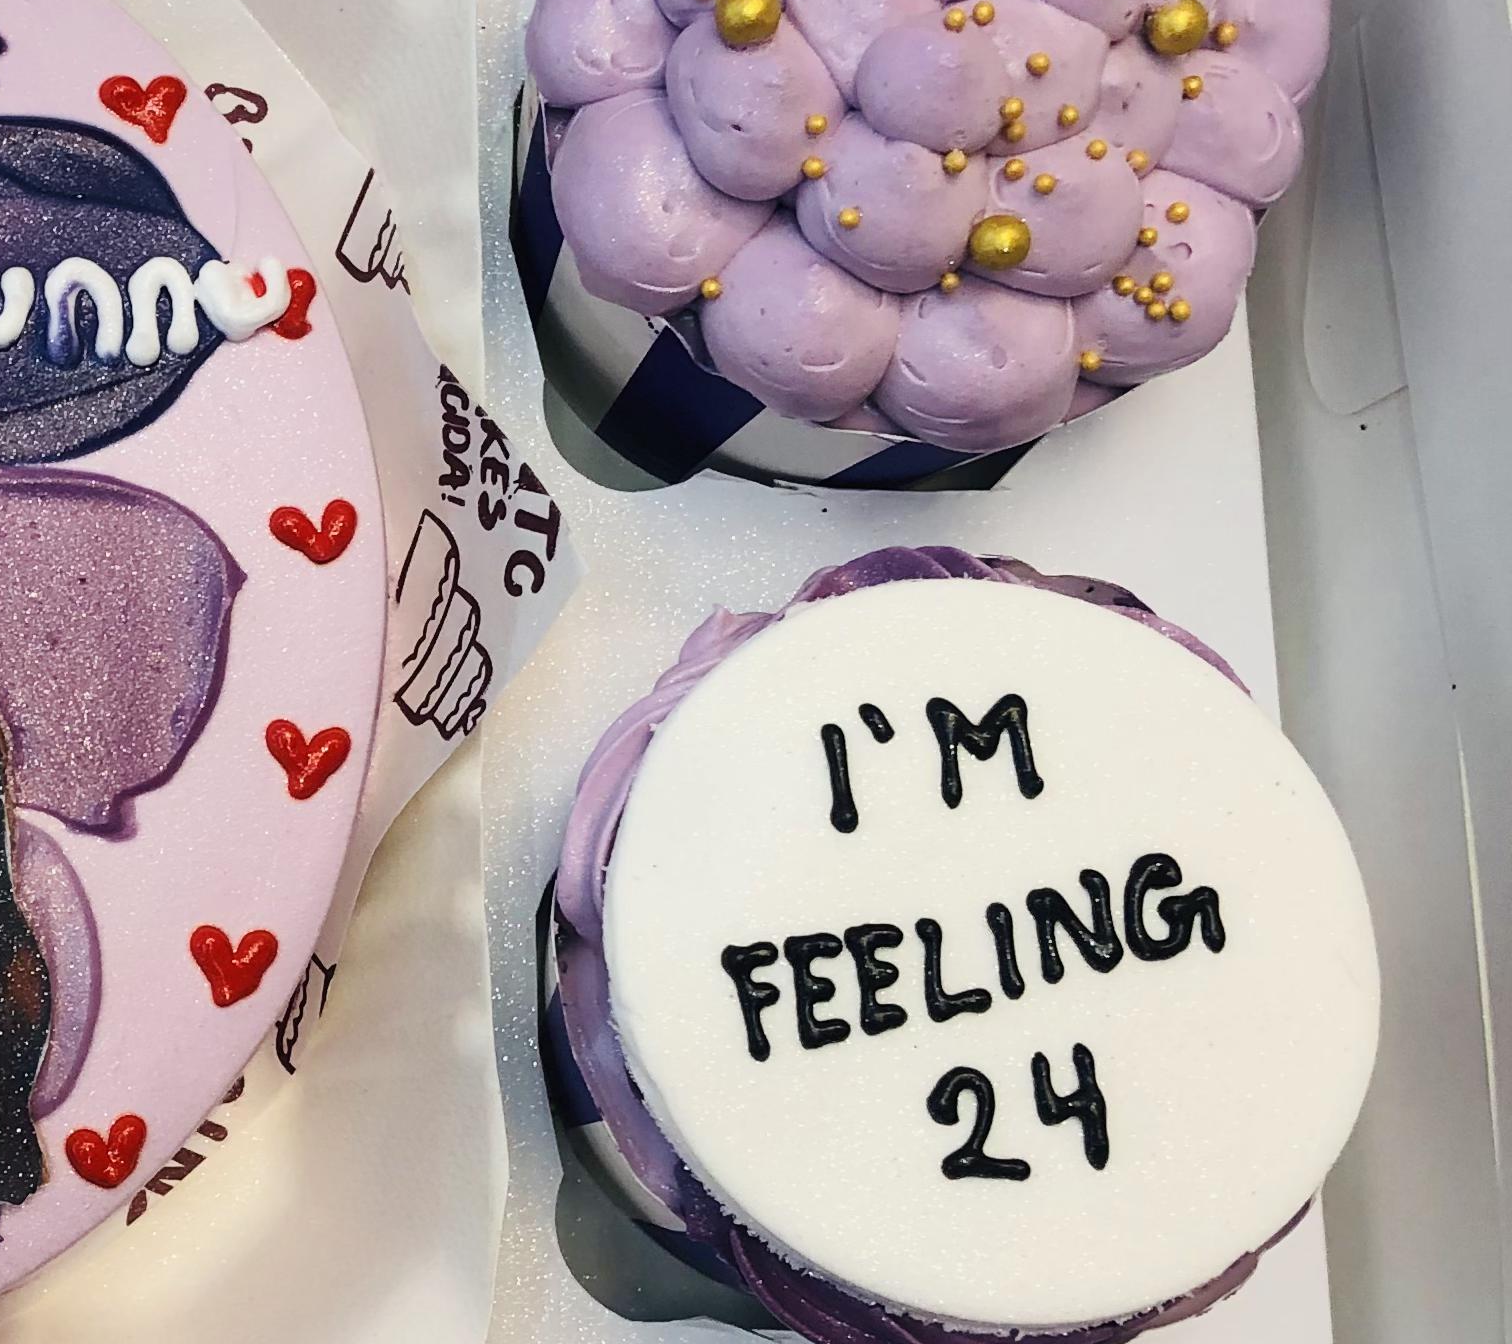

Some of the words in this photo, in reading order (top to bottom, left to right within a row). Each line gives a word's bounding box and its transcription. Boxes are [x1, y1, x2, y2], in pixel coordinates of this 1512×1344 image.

[819, 693, 1045, 834] I'M
[720, 852, 1226, 1062] FEELING
[926, 1042, 1110, 1182] 24
